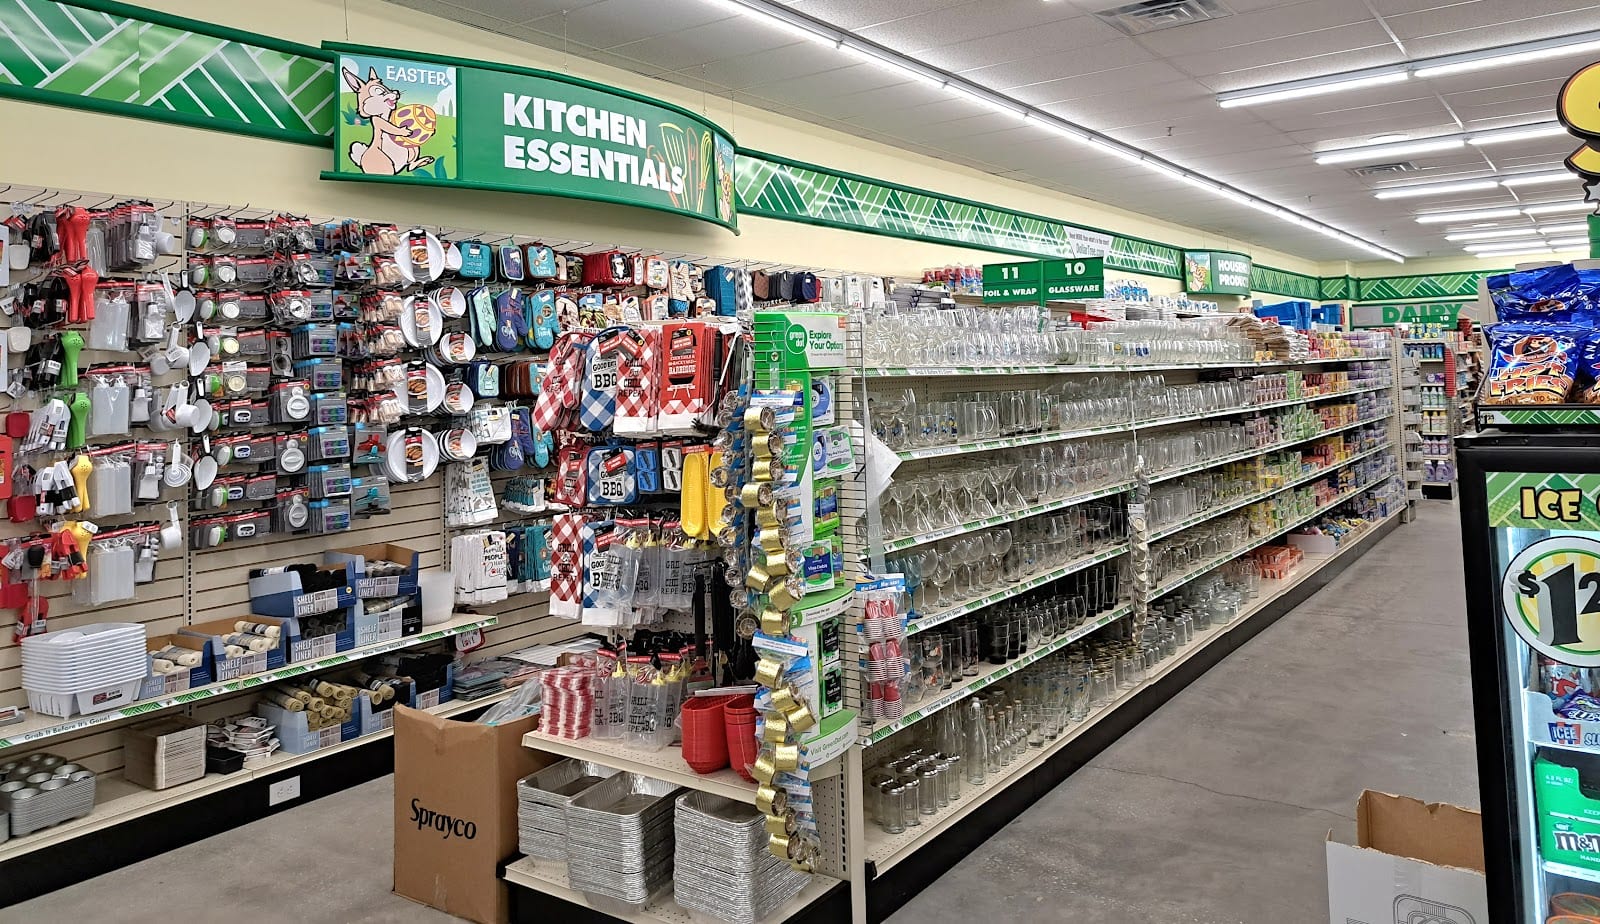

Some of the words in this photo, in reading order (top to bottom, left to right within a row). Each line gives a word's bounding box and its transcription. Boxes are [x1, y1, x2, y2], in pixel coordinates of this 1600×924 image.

[385, 65, 449, 87] EASTER
[503, 92, 648, 149] KITCHEN
[504, 136, 685, 194] ESSENTIALS
[1002, 267, 1019, 280] 11
[1064, 262, 1086, 276] 10
[984, 288, 1000, 297] FOIL
[1012, 288, 1037, 296] WRAP
[1048, 284, 1100, 294] GLASSWARE
[1382, 304, 1463, 323] DAIRY
[809, 330, 832, 340] Explore
[796, 338, 804, 347] dot
[809, 340, 825, 350] Your
[826, 340, 844, 350] Options
[592, 362, 607, 372] GOOD
[1500, 360, 1566, 382] HOT
[624, 378, 642, 388] CHILL
[1490, 374, 1568, 397] FRIES
[617, 389, 645, 398] REPEAT
[602, 482, 623, 496] BBQ
[1520, 486, 1582, 522] ICE
[558, 544, 575, 552] GRILL
[358, 578, 376, 587] SHELF
[552, 573, 577, 581] REPEAT
[358, 587, 374, 598] LINER
[297, 593, 314, 604] SHELF
[298, 604, 314, 615] LINER
[360, 624, 376, 635] SHELF
[360, 632, 378, 644] LINER
[295, 640, 312, 652] SHELF
[296, 650, 312, 661] LINER
[221, 658, 240, 671] SHELF
[222, 669, 240, 680] LINER
[24, 730, 44, 740] Grab
[53, 724, 76, 734] Before
[89, 715, 110, 724] Gone!
[1552, 726, 1577, 740] ICEE
[810, 746, 821, 756] Visit
[822, 731, 849, 752] GreenDot.com
[410, 798, 477, 840] Sprayco
